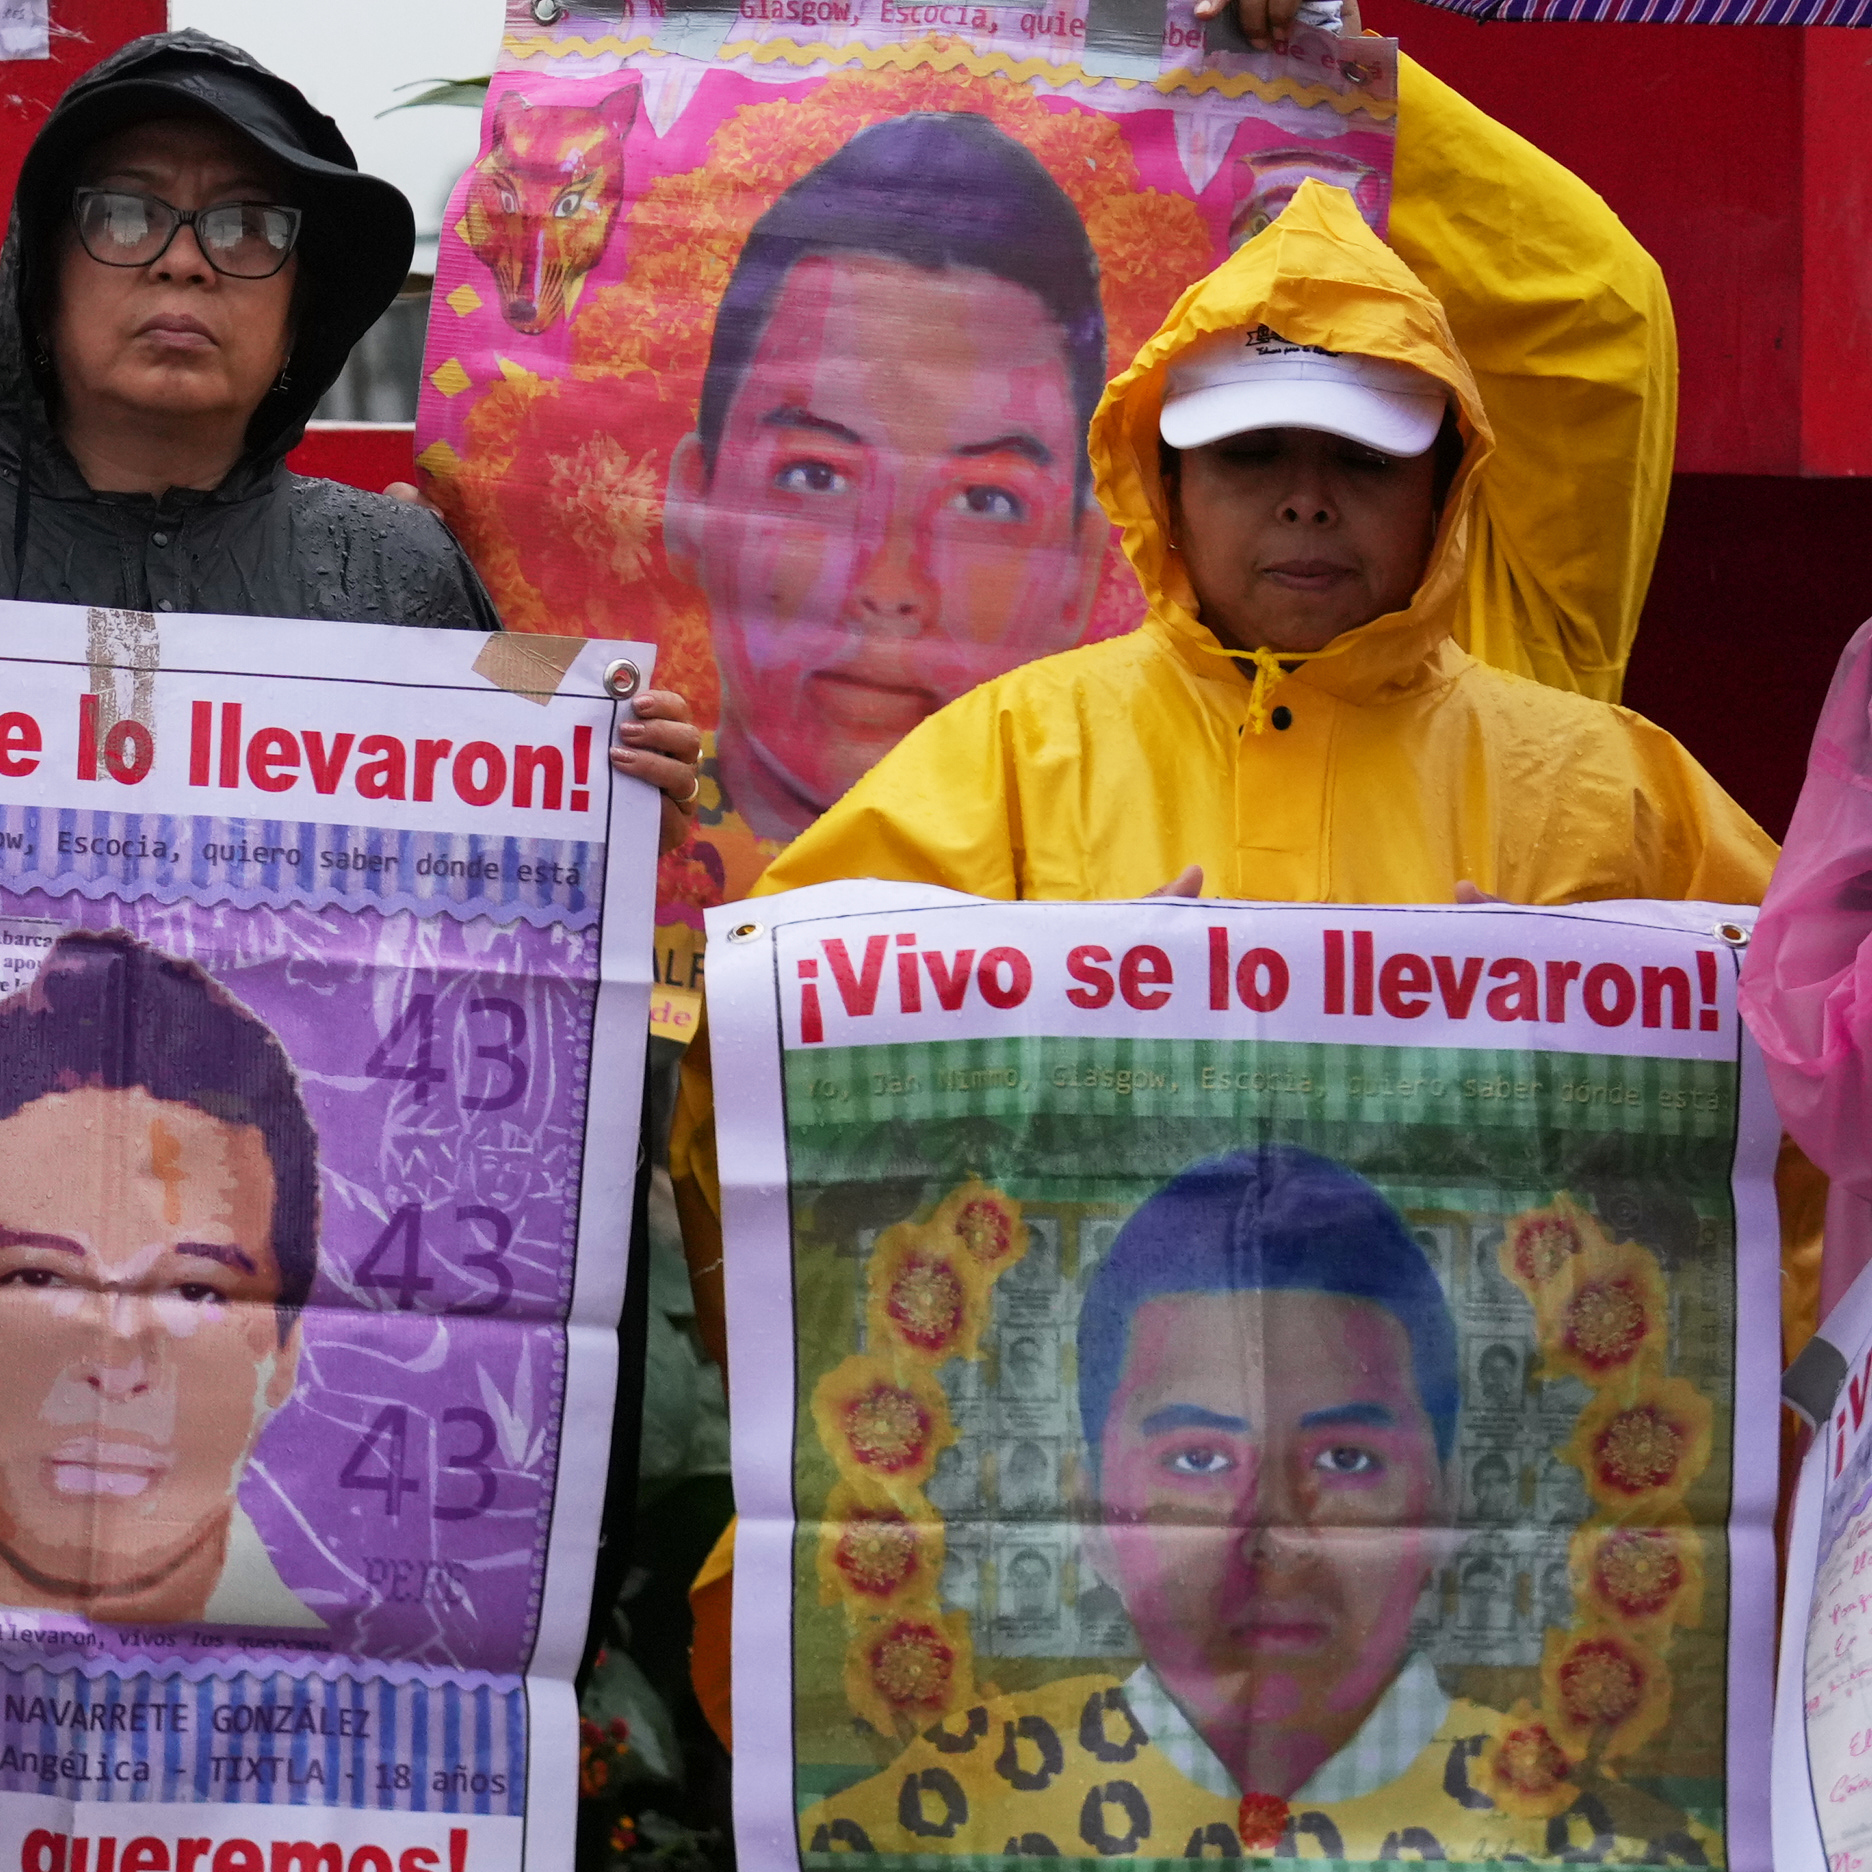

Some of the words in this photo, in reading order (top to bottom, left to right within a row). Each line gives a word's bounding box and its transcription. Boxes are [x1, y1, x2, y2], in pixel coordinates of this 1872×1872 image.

[76, 693, 154, 786] lo
[188, 699, 593, 812] llevaron!
[57, 824, 180, 863] Escocia,
[202, 838, 301, 869] quiero
[319, 845, 398, 873] saber
[416, 849, 499, 881] dónde
[516, 857, 580, 886] está
[797, 932, 1033, 1044] ¡Vivo
[1064, 943, 1174, 1011] se
[1207, 926, 1291, 1013] lo
[1322, 929, 1719, 1032] llevaron!
[365, 993, 528, 1111] 43
[1463, 1076, 1544, 1101] saber
[355, 1203, 514, 1316] 43
[339, 1404, 498, 1521] 43
[0, 1744, 150, 1782] Angélica
[211, 1756, 325, 1786] TIXTLA
[374, 1762, 410, 1790] 18
[432, 1767, 509, 1795] años
[4, 1693, 189, 1733] NAVARRETE
[211, 1700, 371, 1739] GONZÁLEZ
